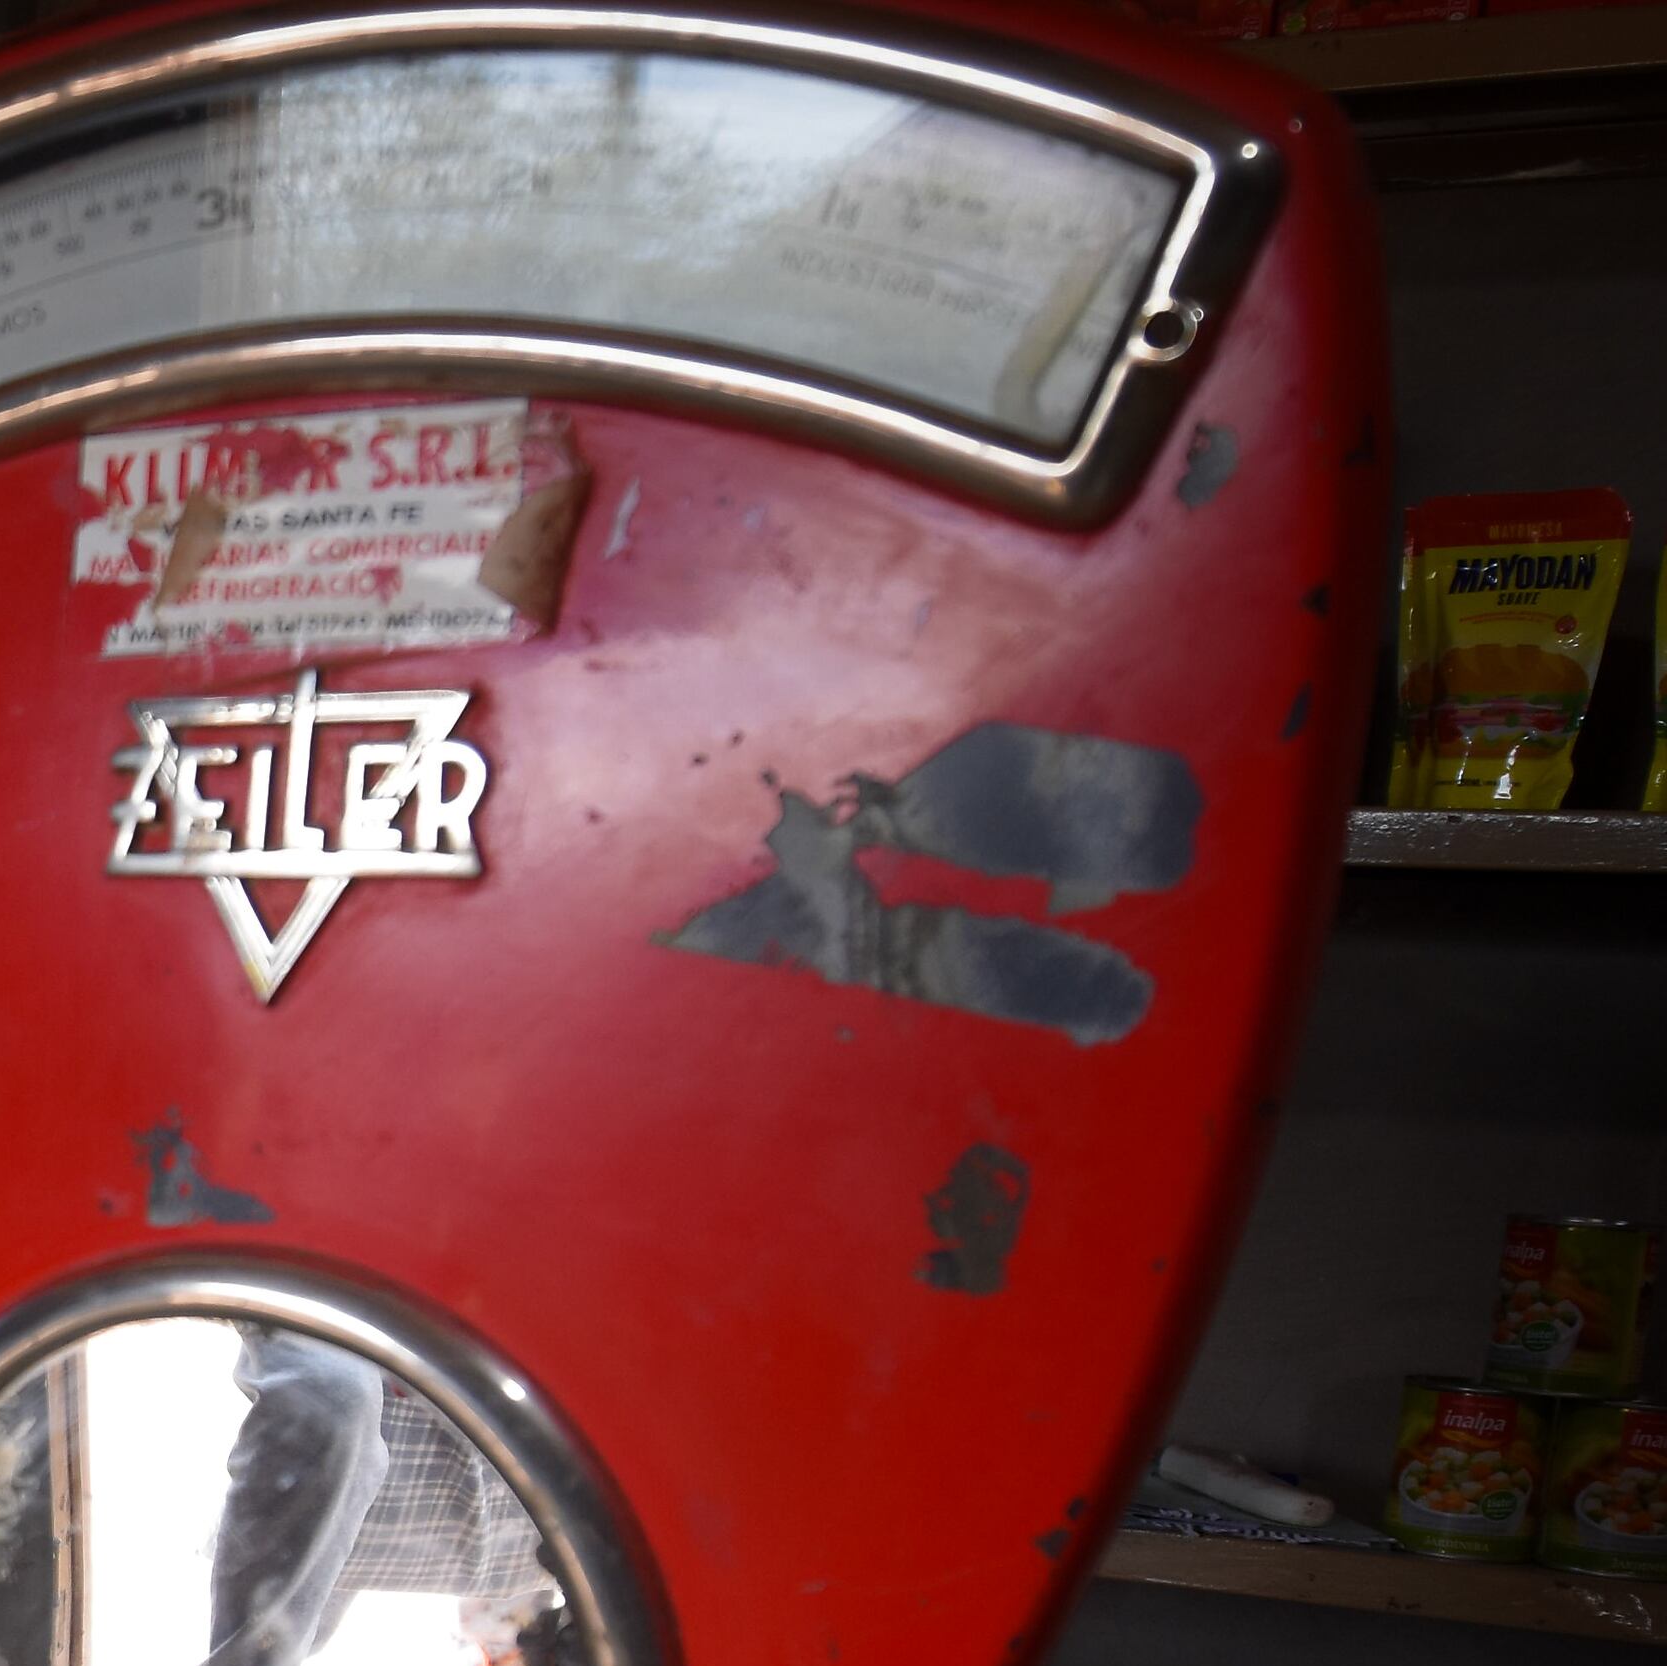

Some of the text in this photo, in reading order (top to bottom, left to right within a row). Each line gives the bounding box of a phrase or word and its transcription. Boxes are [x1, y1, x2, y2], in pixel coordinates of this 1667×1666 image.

[105, 422, 516, 505] KLIMR S.R.L.
[280, 505, 376, 533] SANTA
[389, 503, 424, 521] FE
[1443, 1409, 1508, 1435] inalpa
